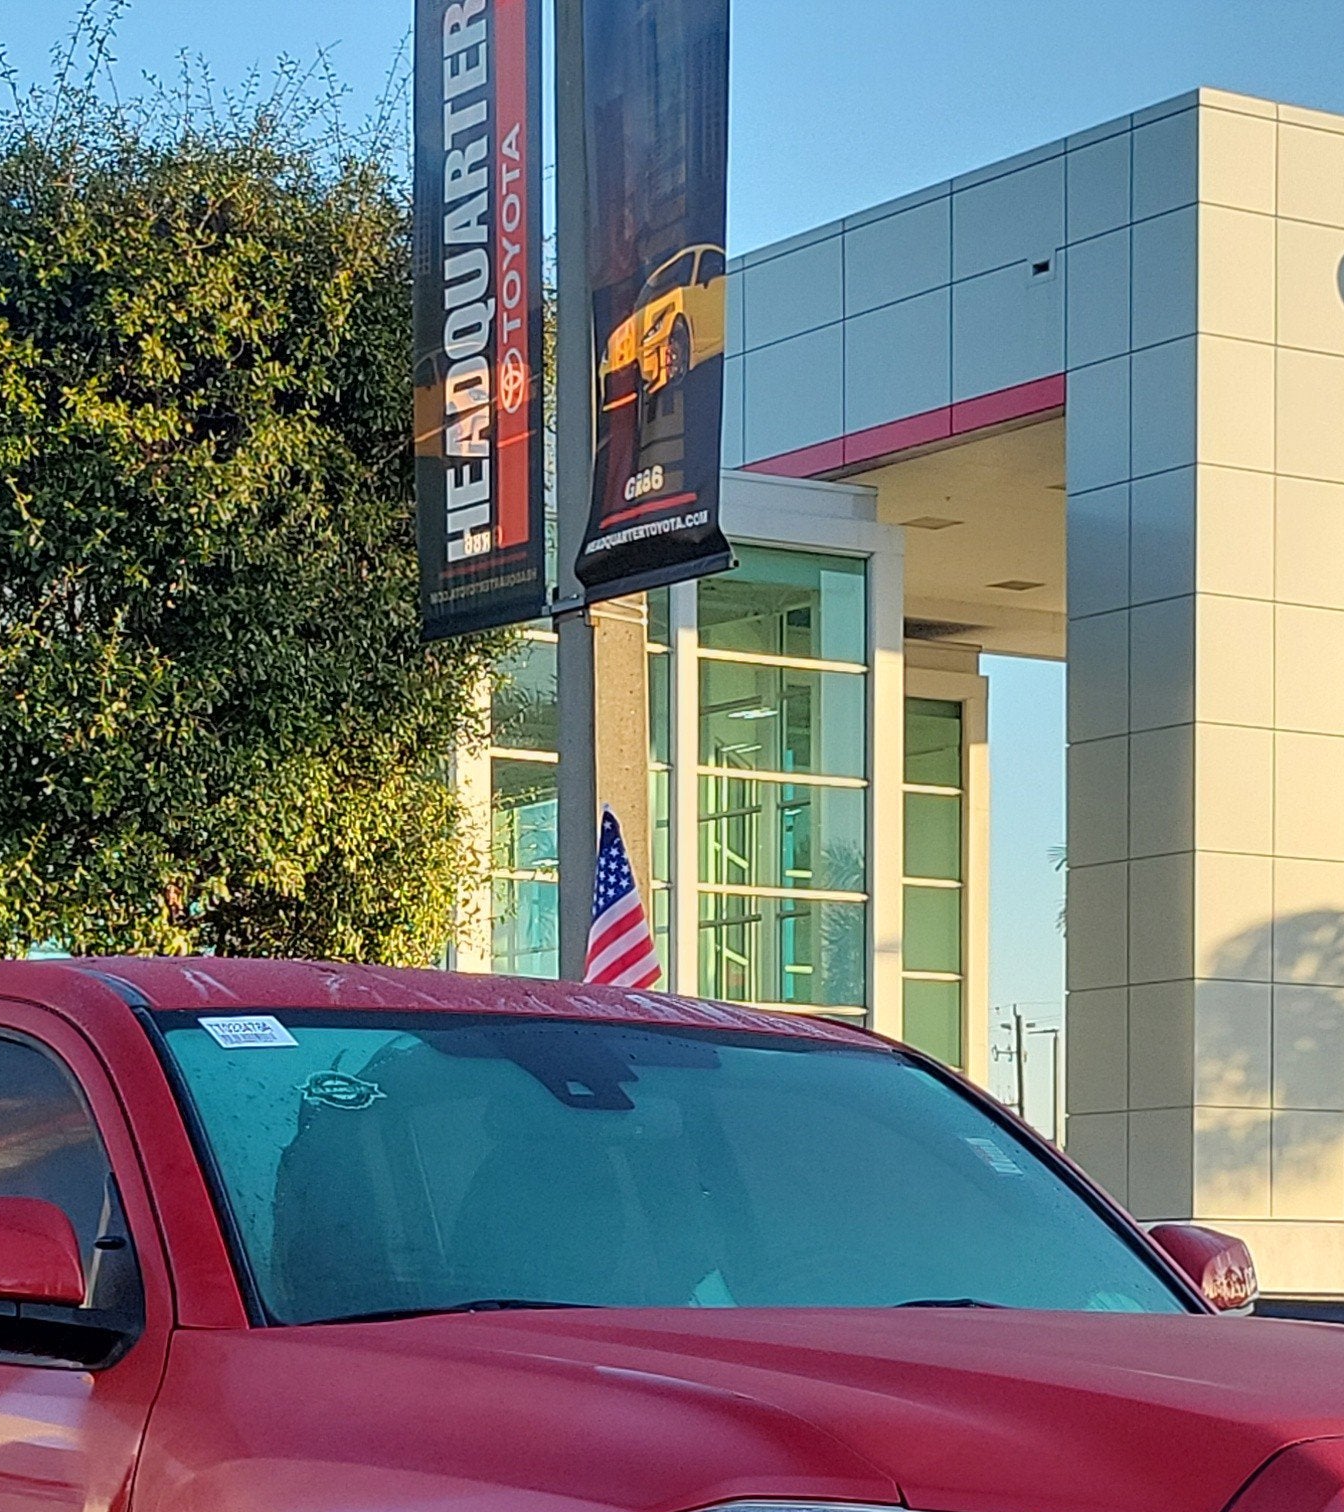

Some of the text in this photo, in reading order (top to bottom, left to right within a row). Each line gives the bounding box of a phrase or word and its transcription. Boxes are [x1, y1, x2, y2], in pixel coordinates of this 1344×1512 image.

[443, 0, 494, 562] HEADQUARTER
[501, 123, 521, 344] TOYOTA
[584, 510, 708, 555] HEADQUARTERTOYOTA.COM
[624, 464, 664, 502] GR86
